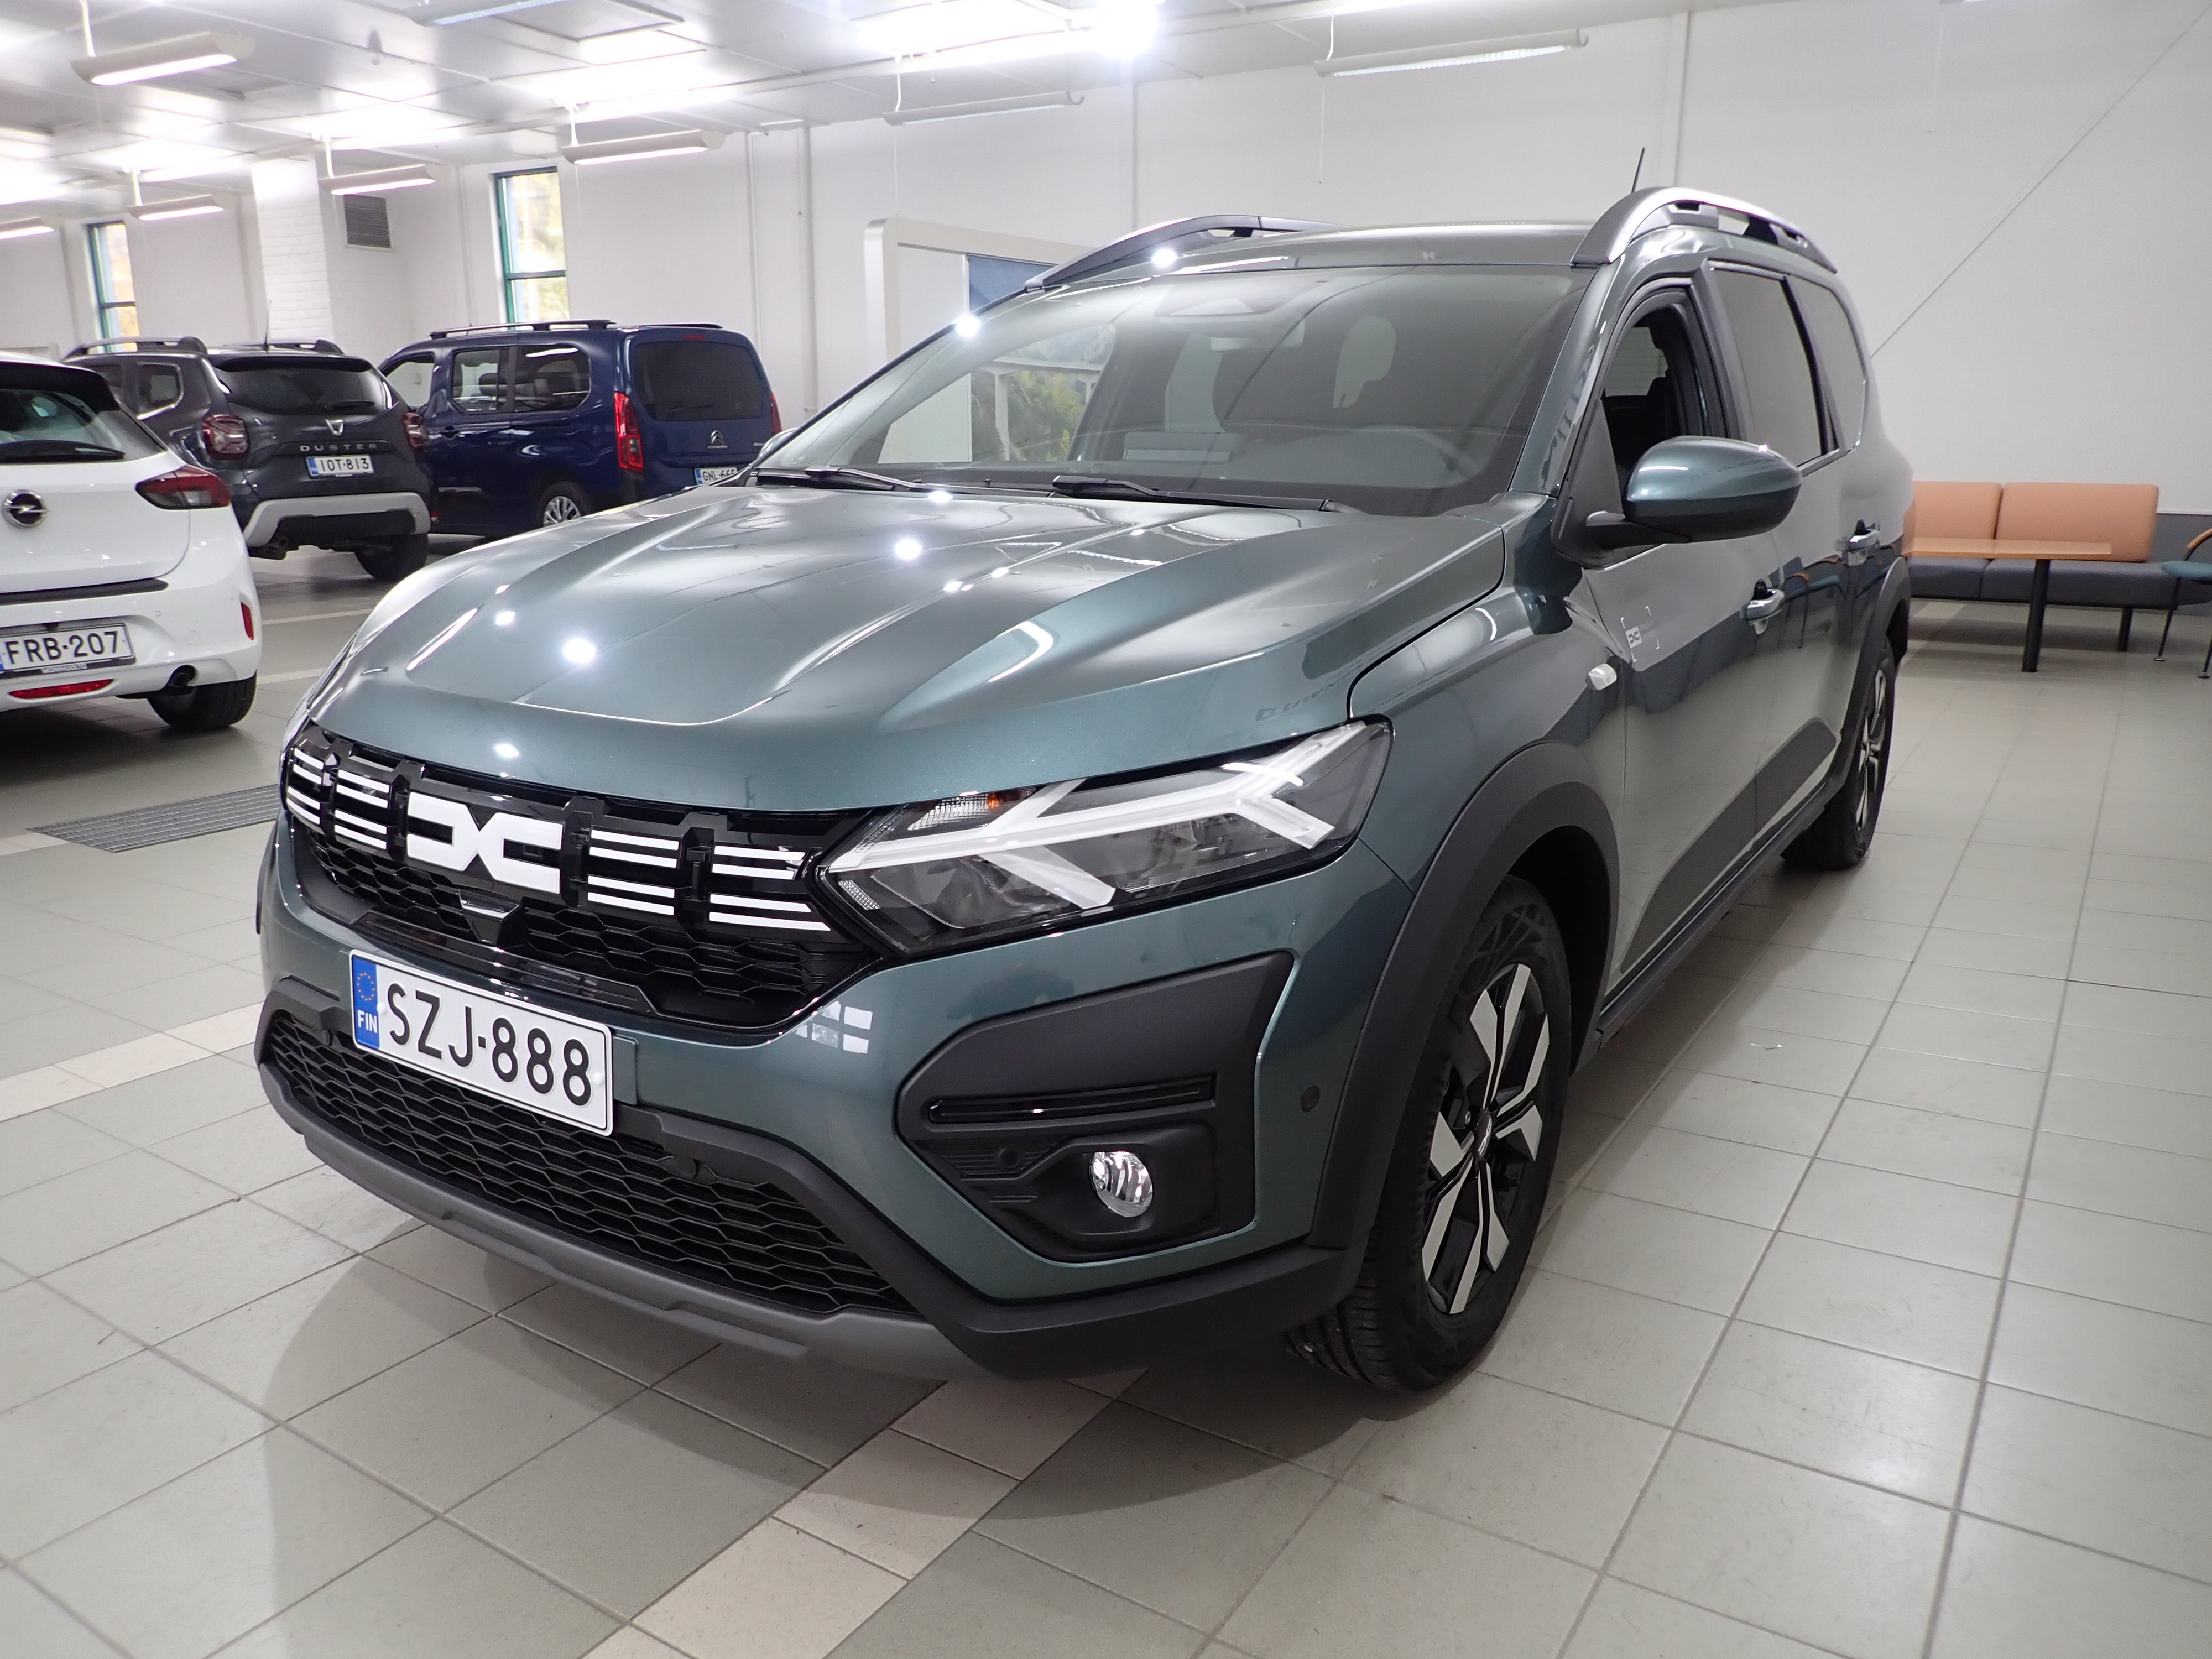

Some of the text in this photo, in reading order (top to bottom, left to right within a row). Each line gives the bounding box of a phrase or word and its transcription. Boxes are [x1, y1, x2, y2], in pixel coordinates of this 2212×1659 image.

[300, 443, 377, 452] DUSTER
[4, 630, 118, 664] FRB-207
[357, 1009, 378, 1034] FIN
[387, 983, 592, 1107] SZJ-888
